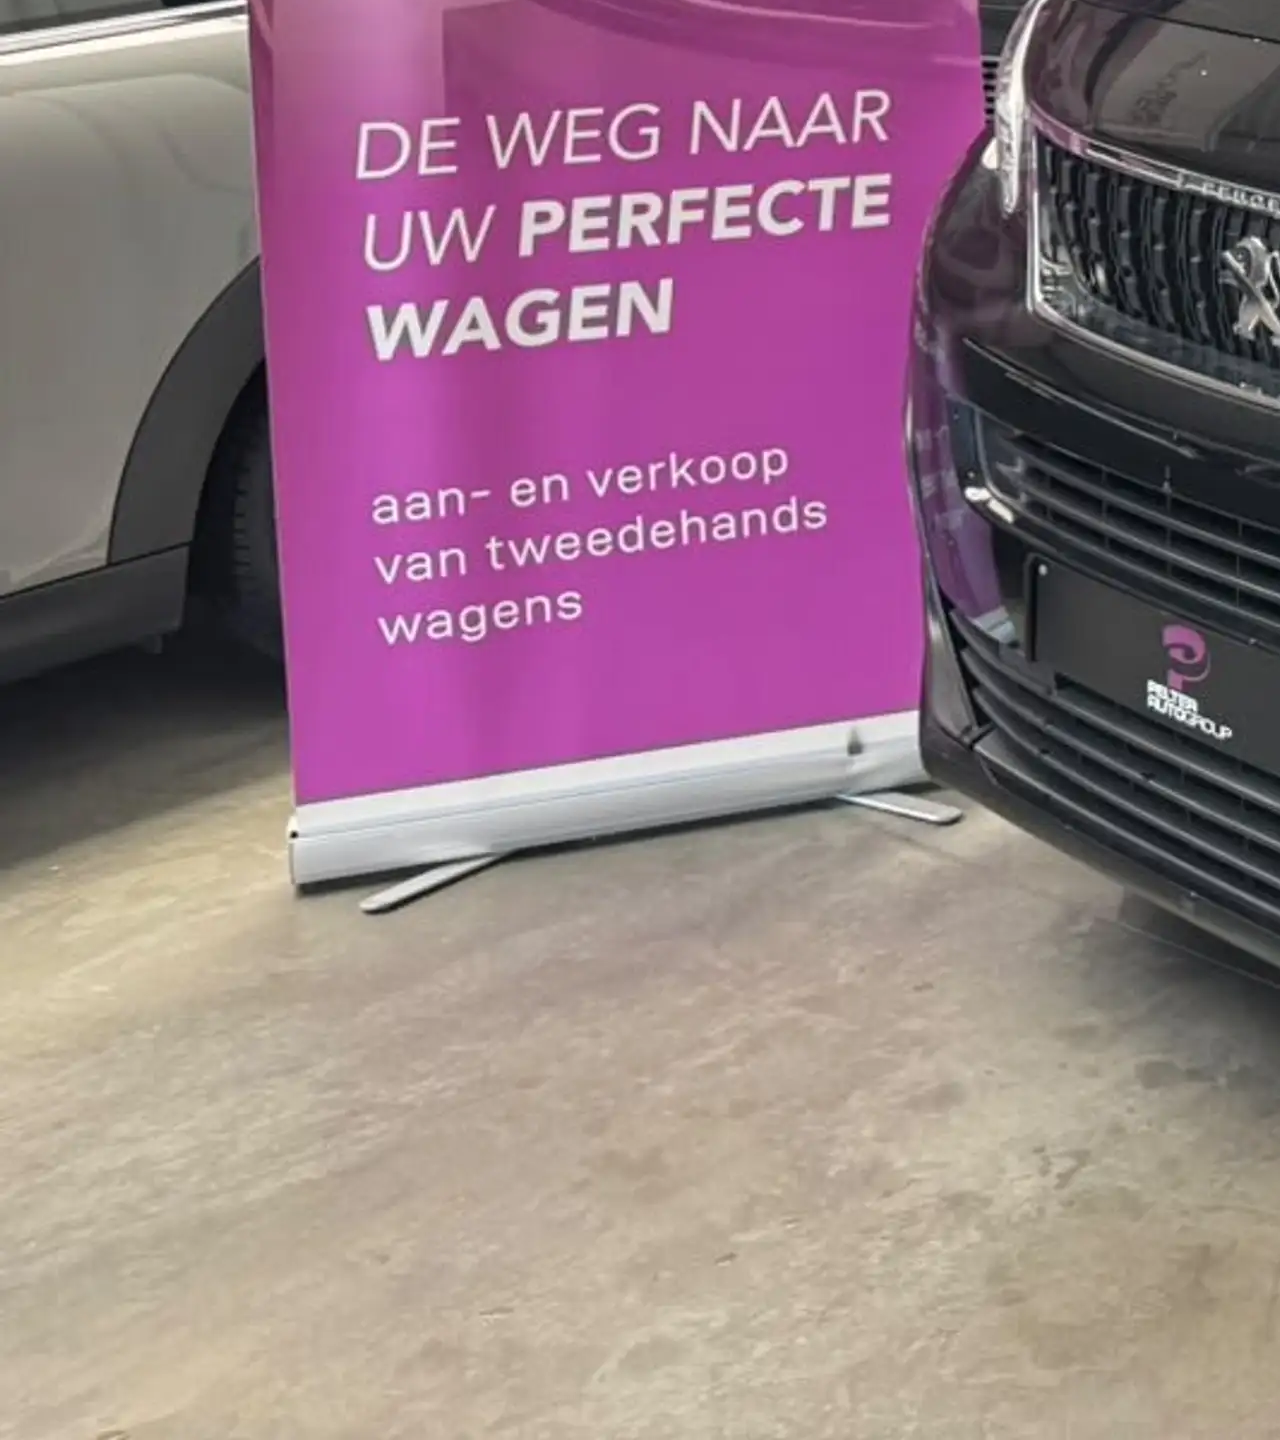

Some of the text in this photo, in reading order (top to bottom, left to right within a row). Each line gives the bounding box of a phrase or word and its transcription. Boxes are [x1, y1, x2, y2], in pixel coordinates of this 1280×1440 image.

[355, 88, 892, 179] DE WEG NAAR
[363, 173, 892, 271] UW PERFECTE
[366, 277, 674, 361] WAGEN
[371, 446, 789, 524] aan- en verkoop
[374, 496, 828, 585] van tweedehands
[378, 588, 583, 645] wagens
